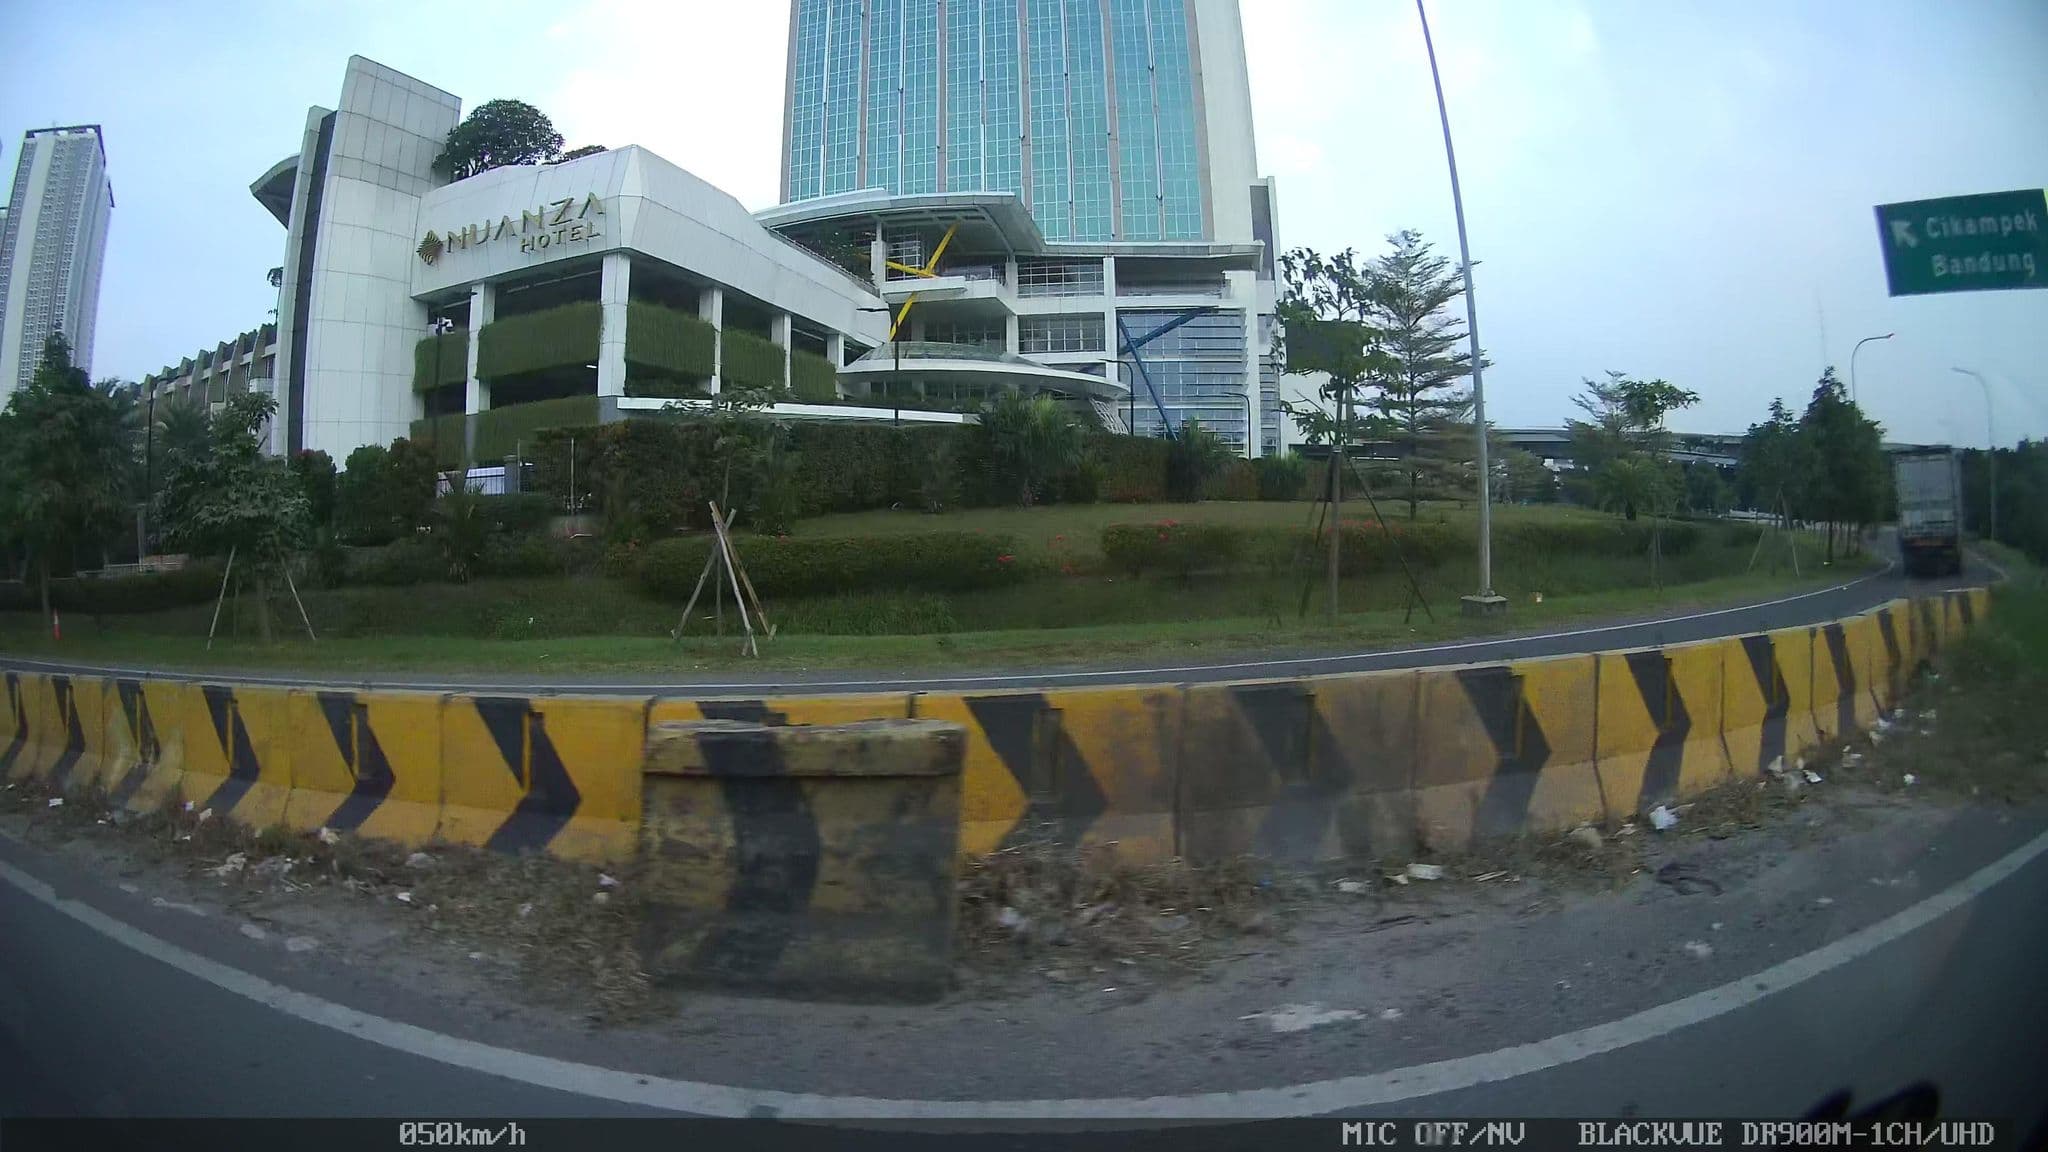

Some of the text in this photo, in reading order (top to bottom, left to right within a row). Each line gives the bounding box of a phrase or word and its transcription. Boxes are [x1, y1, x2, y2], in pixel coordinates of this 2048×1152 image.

[447, 192, 604, 253] NUANZA
[1926, 211, 2038, 238] Cikampek
[521, 222, 600, 253] HOTEL
[1932, 252, 2035, 278] Bandung
